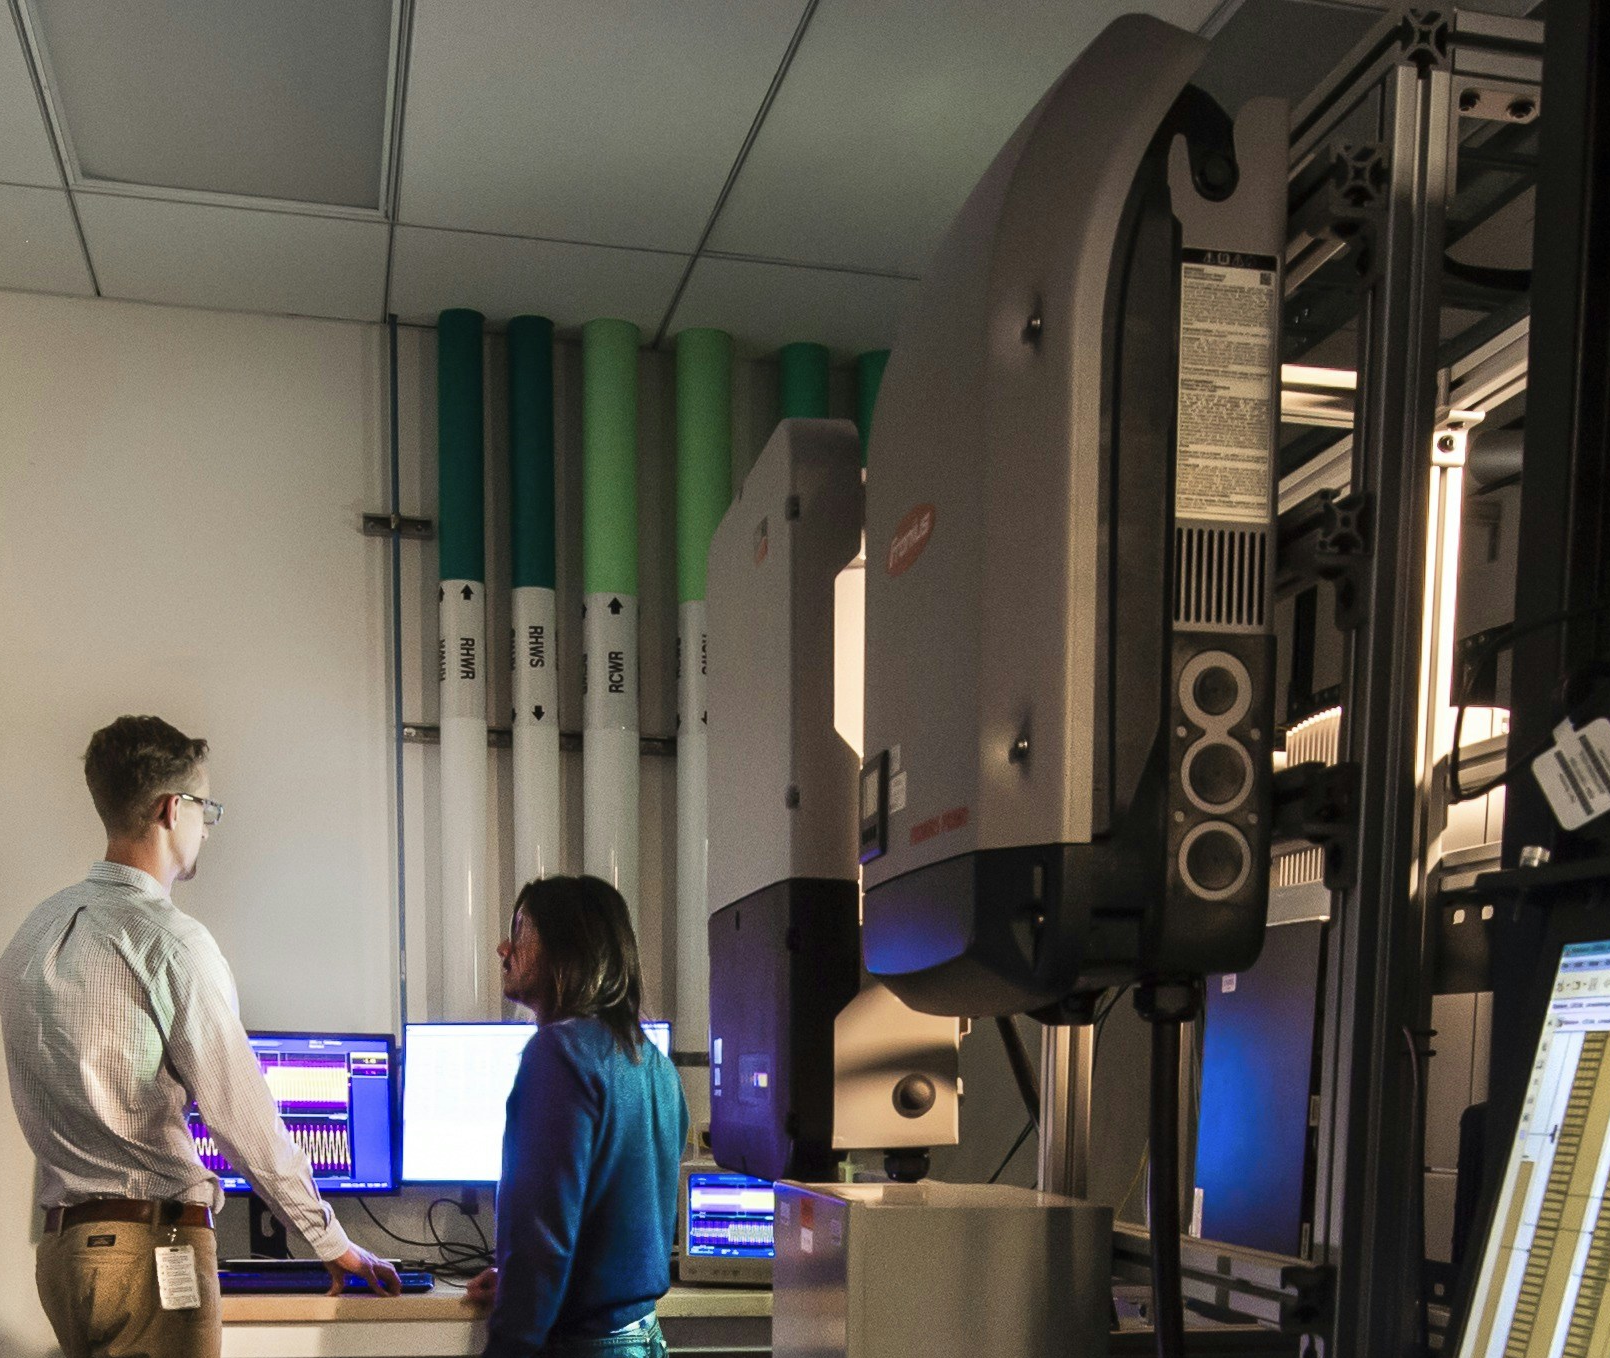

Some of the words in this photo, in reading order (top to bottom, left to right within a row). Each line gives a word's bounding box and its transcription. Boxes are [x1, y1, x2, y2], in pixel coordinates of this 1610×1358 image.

[459, 637, 476, 680] RHWR
[528, 625, 545, 669] RHWS
[608, 651, 625, 694] RCWR
